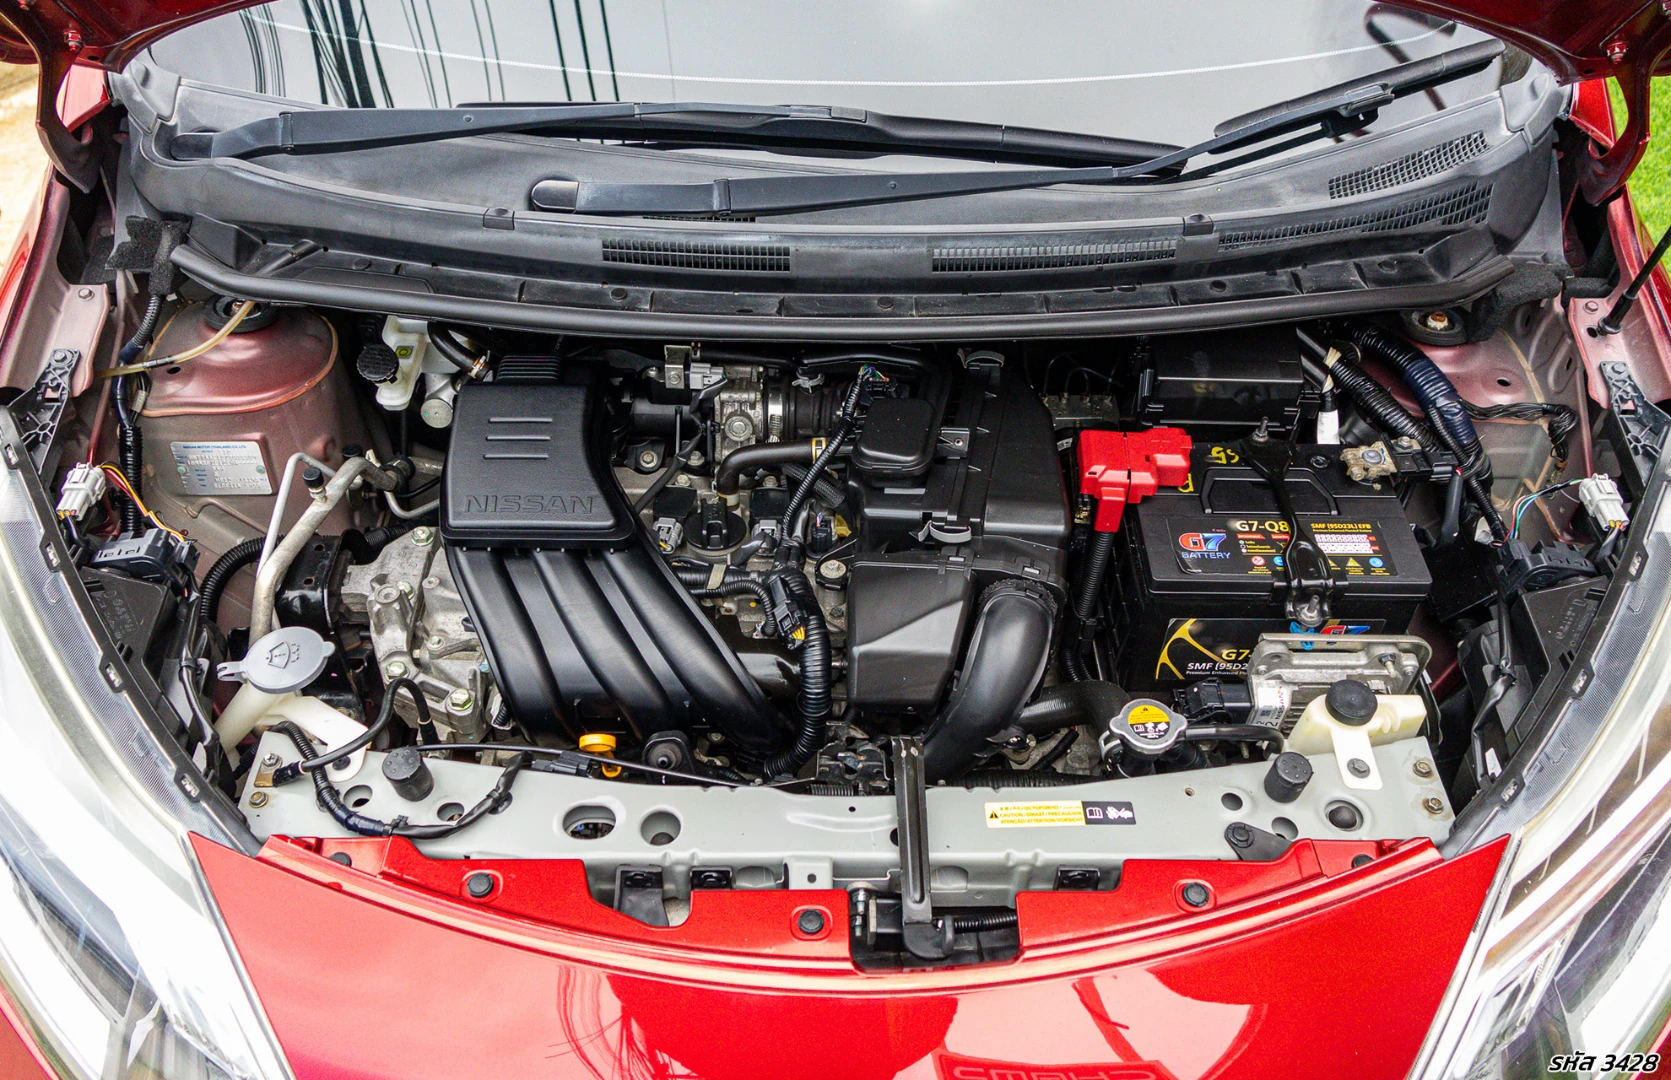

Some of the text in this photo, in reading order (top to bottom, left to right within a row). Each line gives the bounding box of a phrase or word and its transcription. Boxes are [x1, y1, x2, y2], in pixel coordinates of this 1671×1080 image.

[464, 494, 594, 515] NISSAN
[1178, 532, 1227, 552] G7
[1187, 662, 1213, 670] SMF
